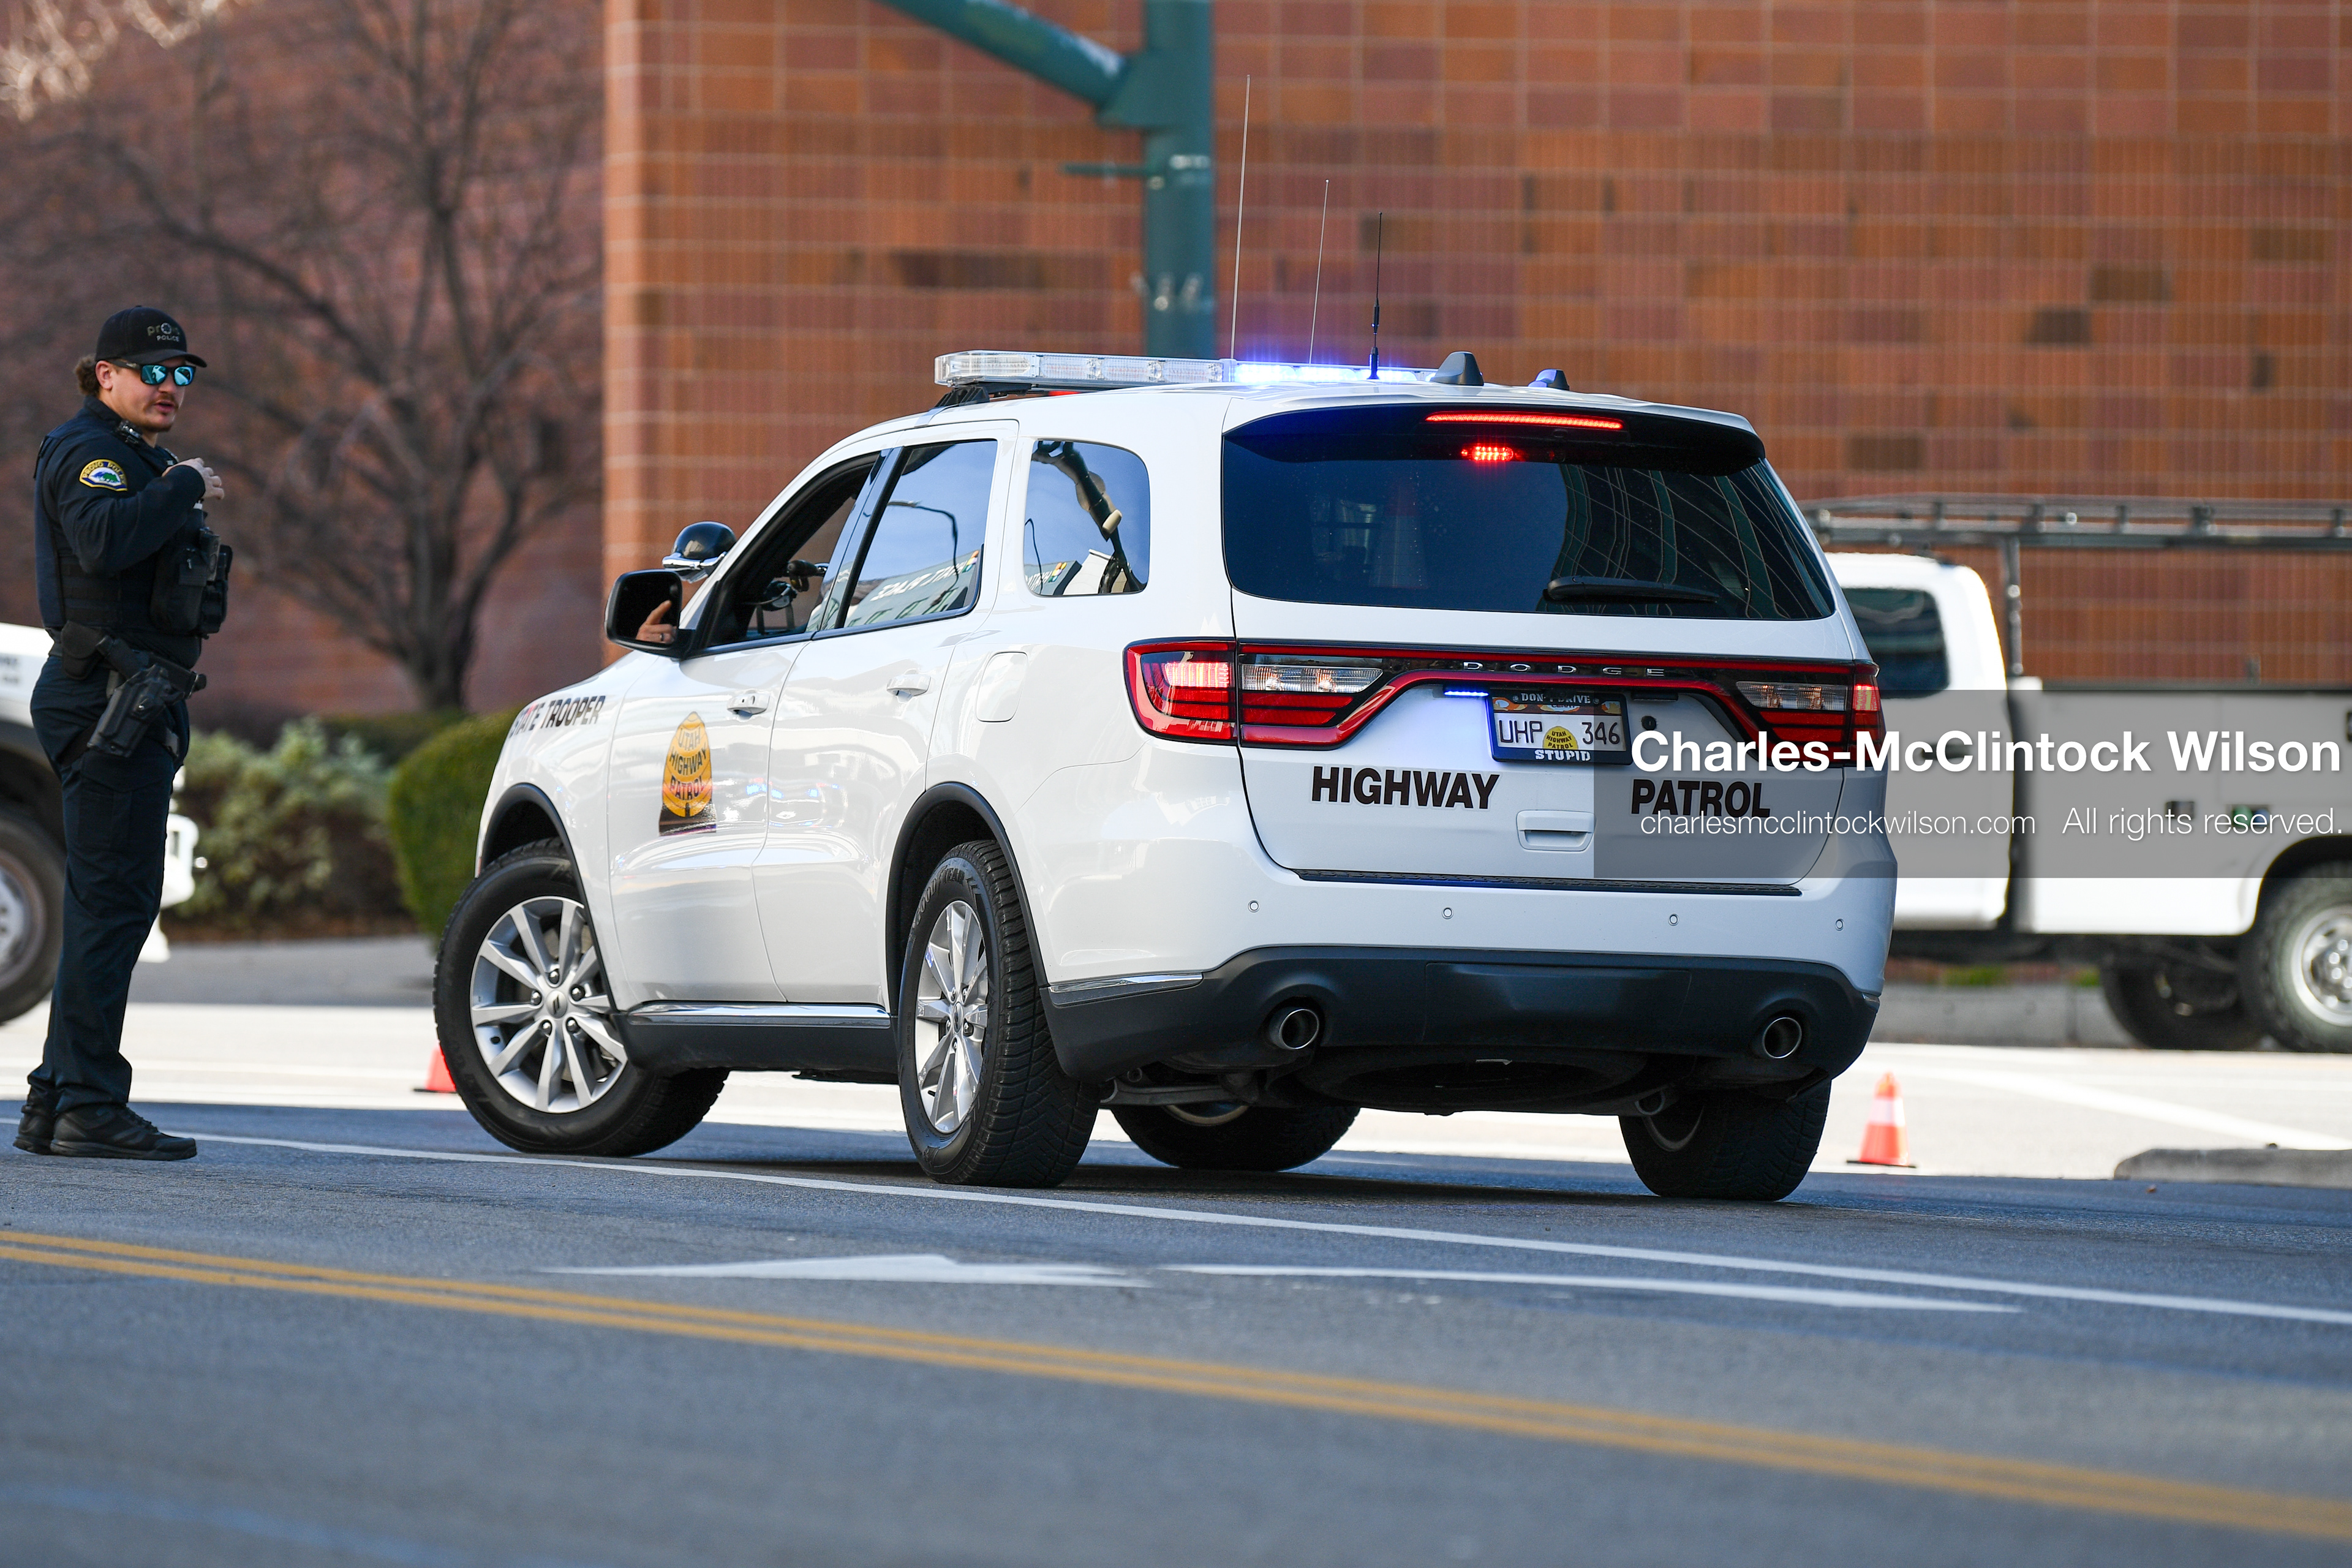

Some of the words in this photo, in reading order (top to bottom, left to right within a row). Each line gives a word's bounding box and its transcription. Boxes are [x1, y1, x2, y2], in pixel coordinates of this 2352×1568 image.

[147, 322, 180, 336] pro
[82, 462, 104, 478] PROVO
[1463, 661, 1665, 677] DODGE
[540, 695, 606, 729] TROOPER
[678, 726, 701, 752] UTAH
[1499, 720, 1542, 743] UHP
[1581, 722, 1620, 745] 346
[1546, 735, 1573, 744] HIGHWAY
[668, 742, 707, 776] HIGHWAY
[1534, 749, 1591, 761] STUPID
[670, 774, 705, 801] PATROL
[1311, 766, 1499, 809] HIGHWAY
[1631, 778, 1771, 818] PATROL
